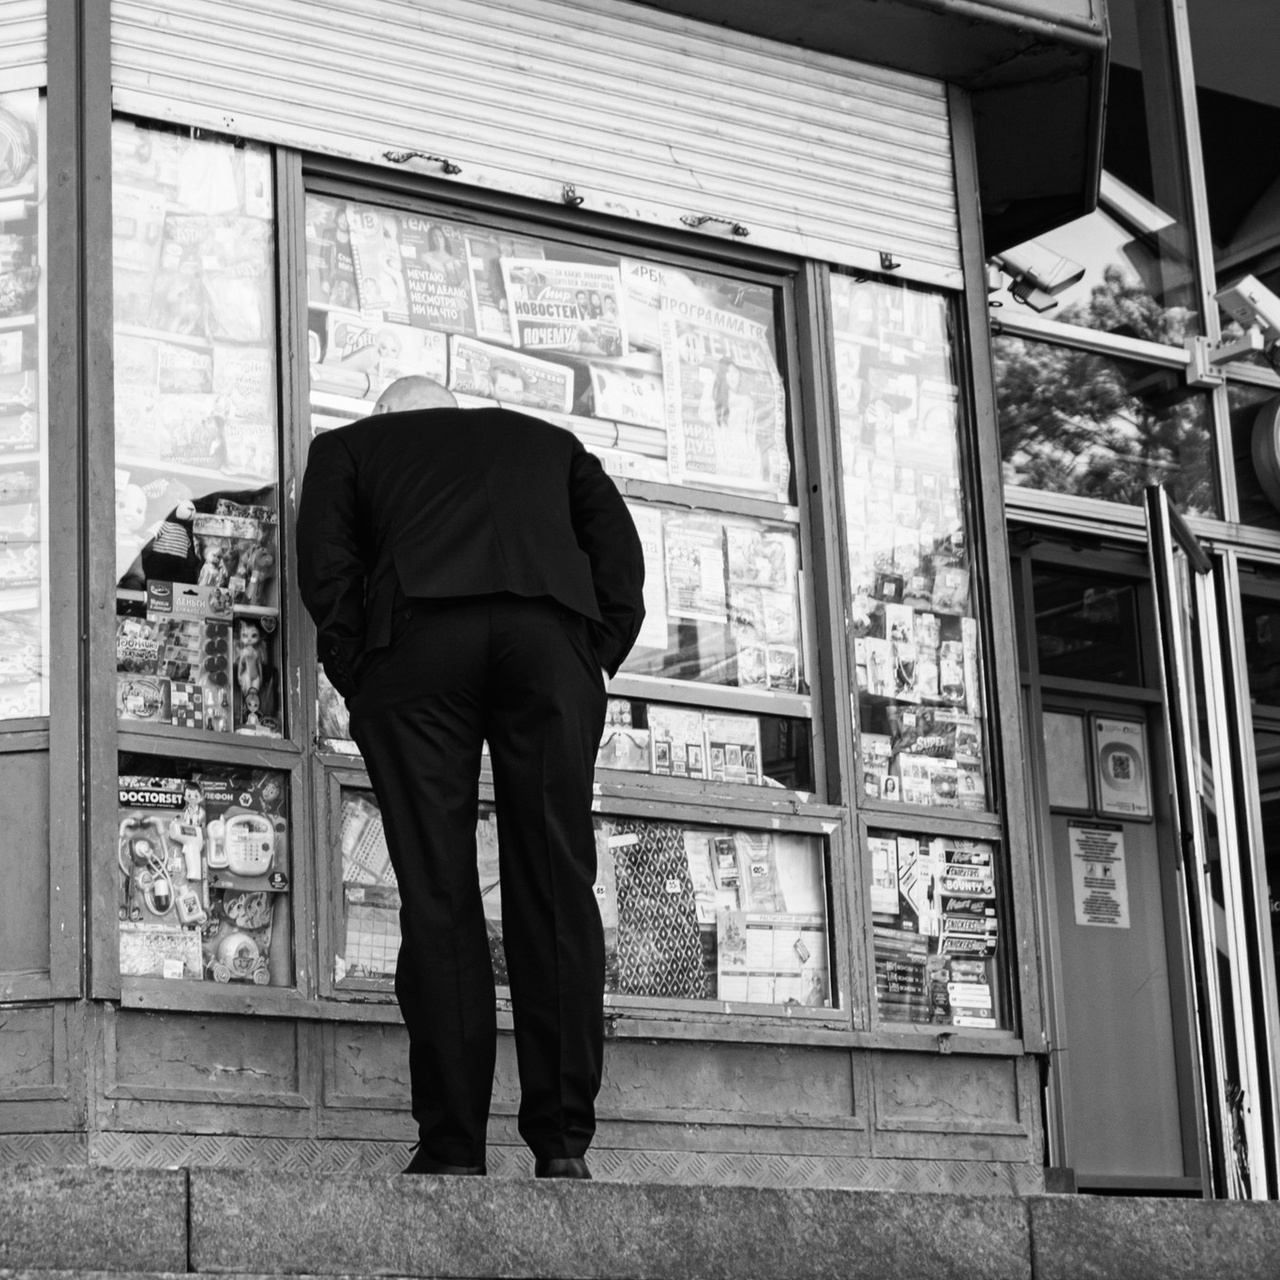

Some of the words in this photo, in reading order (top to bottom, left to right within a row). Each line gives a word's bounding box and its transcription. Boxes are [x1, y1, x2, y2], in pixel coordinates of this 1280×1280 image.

[411, 292, 456, 307] НЕСМОТРЯ
[537, 286, 571, 302] Мир
[413, 304, 426, 315] НИ
[427, 306, 439, 317] НА
[440, 307, 458, 320] ЧТО
[661, 295, 745, 335] ПРОГРАММА
[749, 323, 764, 340] ТВ
[176, 597, 206, 608] ДЕНЬГИ
[119, 791, 183, 805] DOCTORSET
[204, 792, 234, 802] ЛЕФОН
[946, 879, 983, 893] BOUNTY
